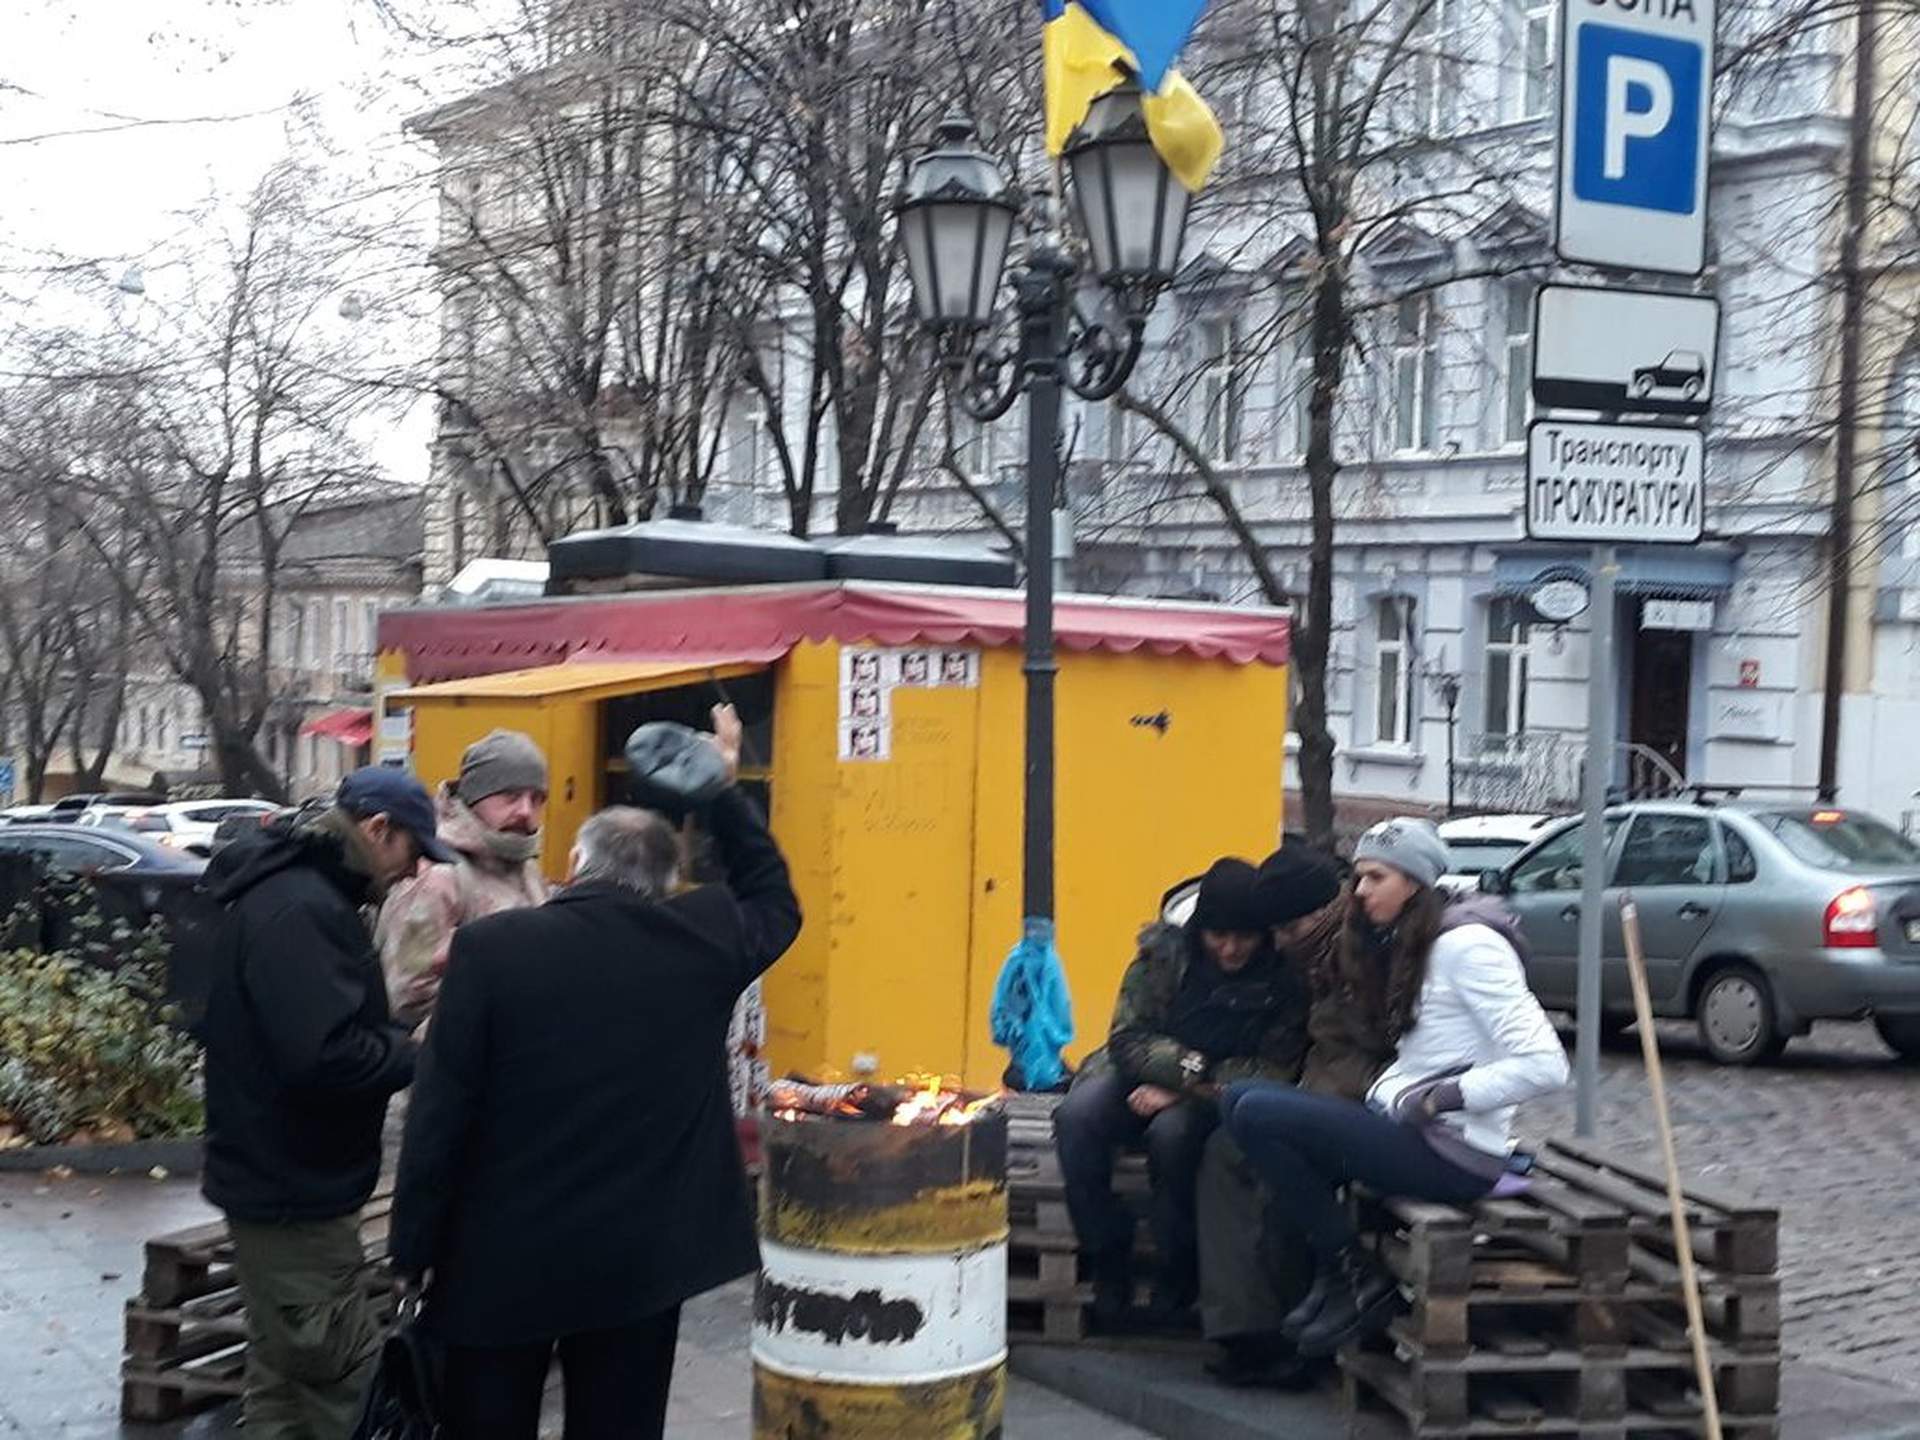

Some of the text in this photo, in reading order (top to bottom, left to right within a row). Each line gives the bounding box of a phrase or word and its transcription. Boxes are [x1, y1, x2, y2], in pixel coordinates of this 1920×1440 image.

[1603, 54, 1674, 180] P
[1547, 429, 1690, 477] Транспорту
[1534, 477, 1697, 526] ПРОКУРАТУРИ
